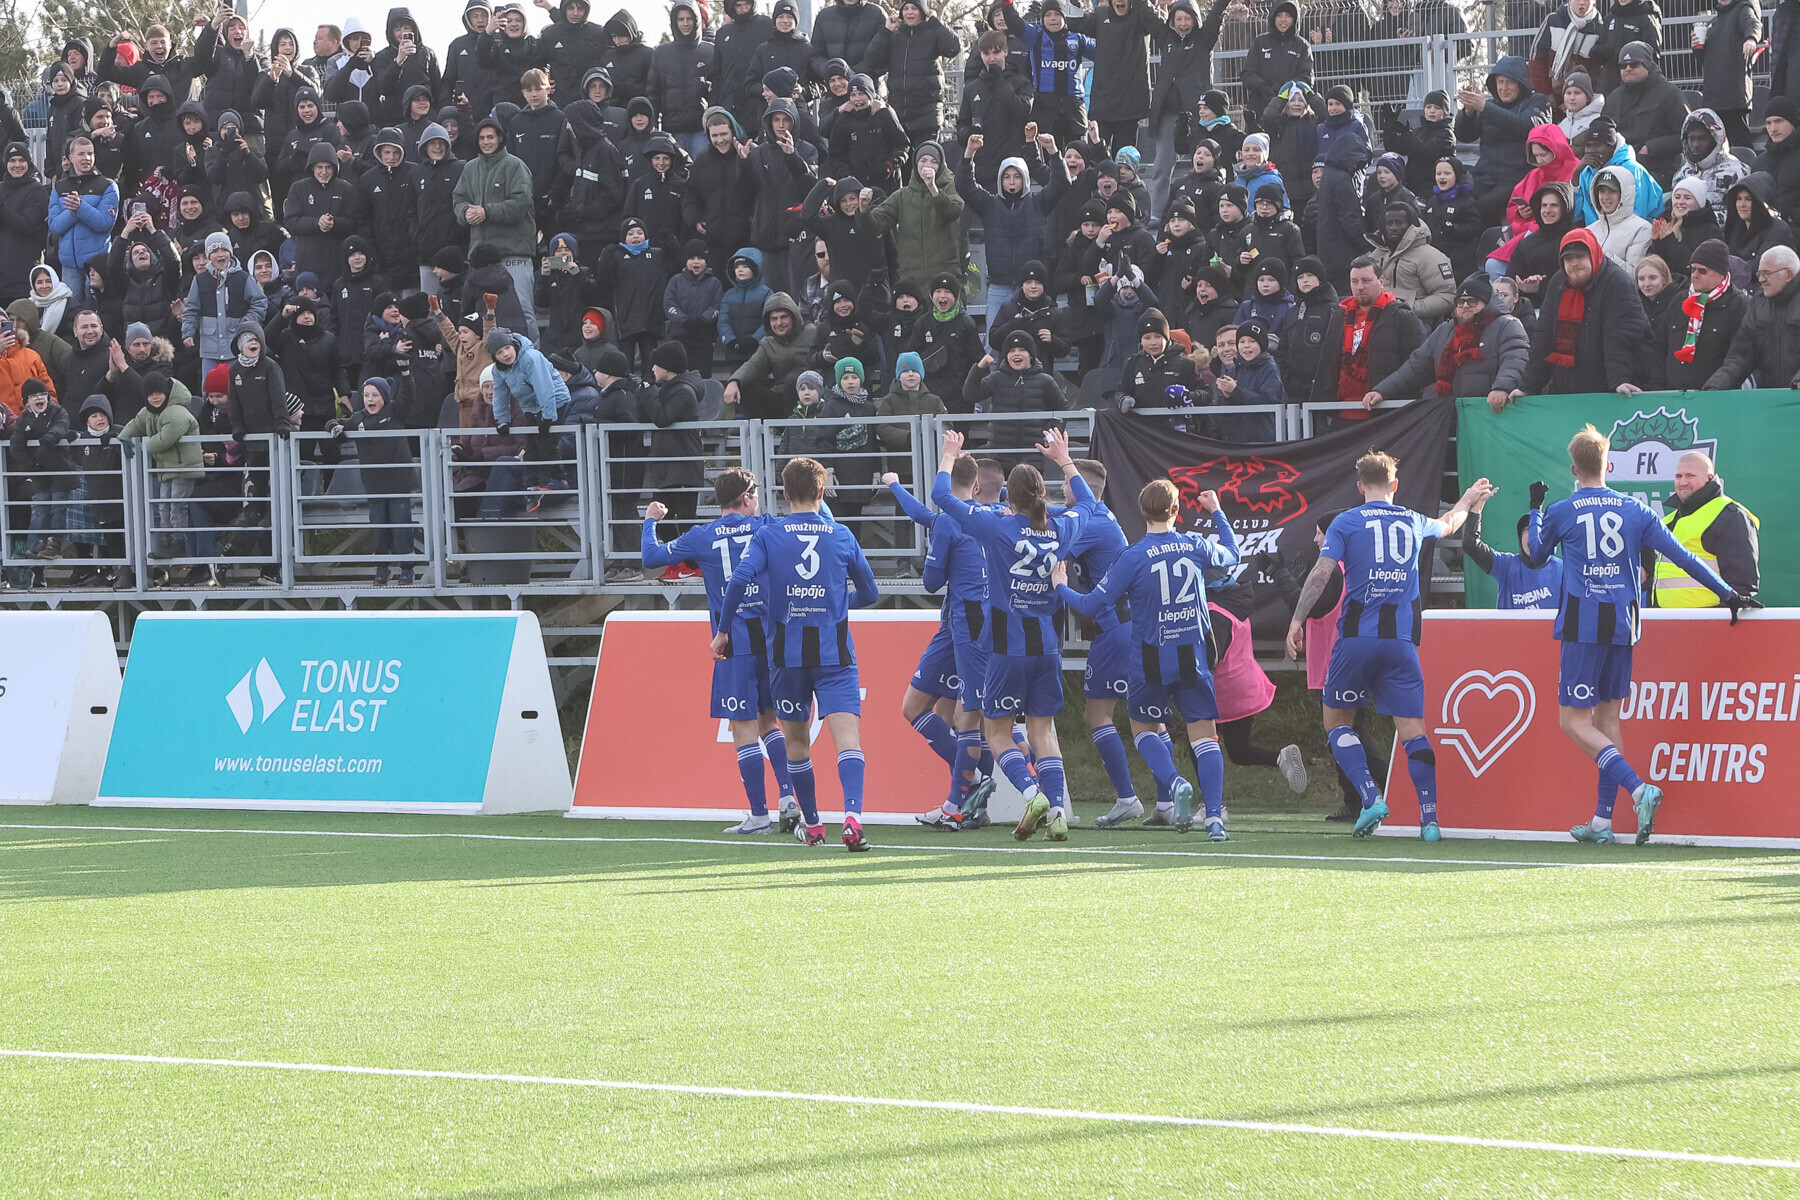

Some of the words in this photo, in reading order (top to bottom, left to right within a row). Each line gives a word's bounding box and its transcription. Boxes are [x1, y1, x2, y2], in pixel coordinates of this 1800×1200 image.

[505, 259, 529, 267] DEPT.
[1636, 452, 1660, 475] FK
[1194, 518, 1218, 529] FA
[1232, 519, 1270, 529] CLUB
[1365, 519, 1413, 565] 10
[1576, 510, 1625, 560] 18
[794, 534, 821, 581] 3
[1009, 539, 1060, 579] 23
[1369, 568, 1407, 583] Liepāja
[1582, 562, 1620, 578] Liepāja
[1010, 578, 1049, 594] Liepāja
[1150, 556, 1196, 606] 12
[786, 584, 826, 599] Liepāja
[1158, 606, 1196, 623] Liepāja
[300, 659, 403, 694] TONUS
[939, 673, 960, 690] LO
[1106, 679, 1128, 693] LO
[721, 696, 746, 711] LOC
[1618, 680, 1690, 721] ORTA
[290, 698, 388, 733] ELAST
[214, 754, 383, 774] www.tonuselast.com
[1649, 742, 1768, 784] CENTRS
